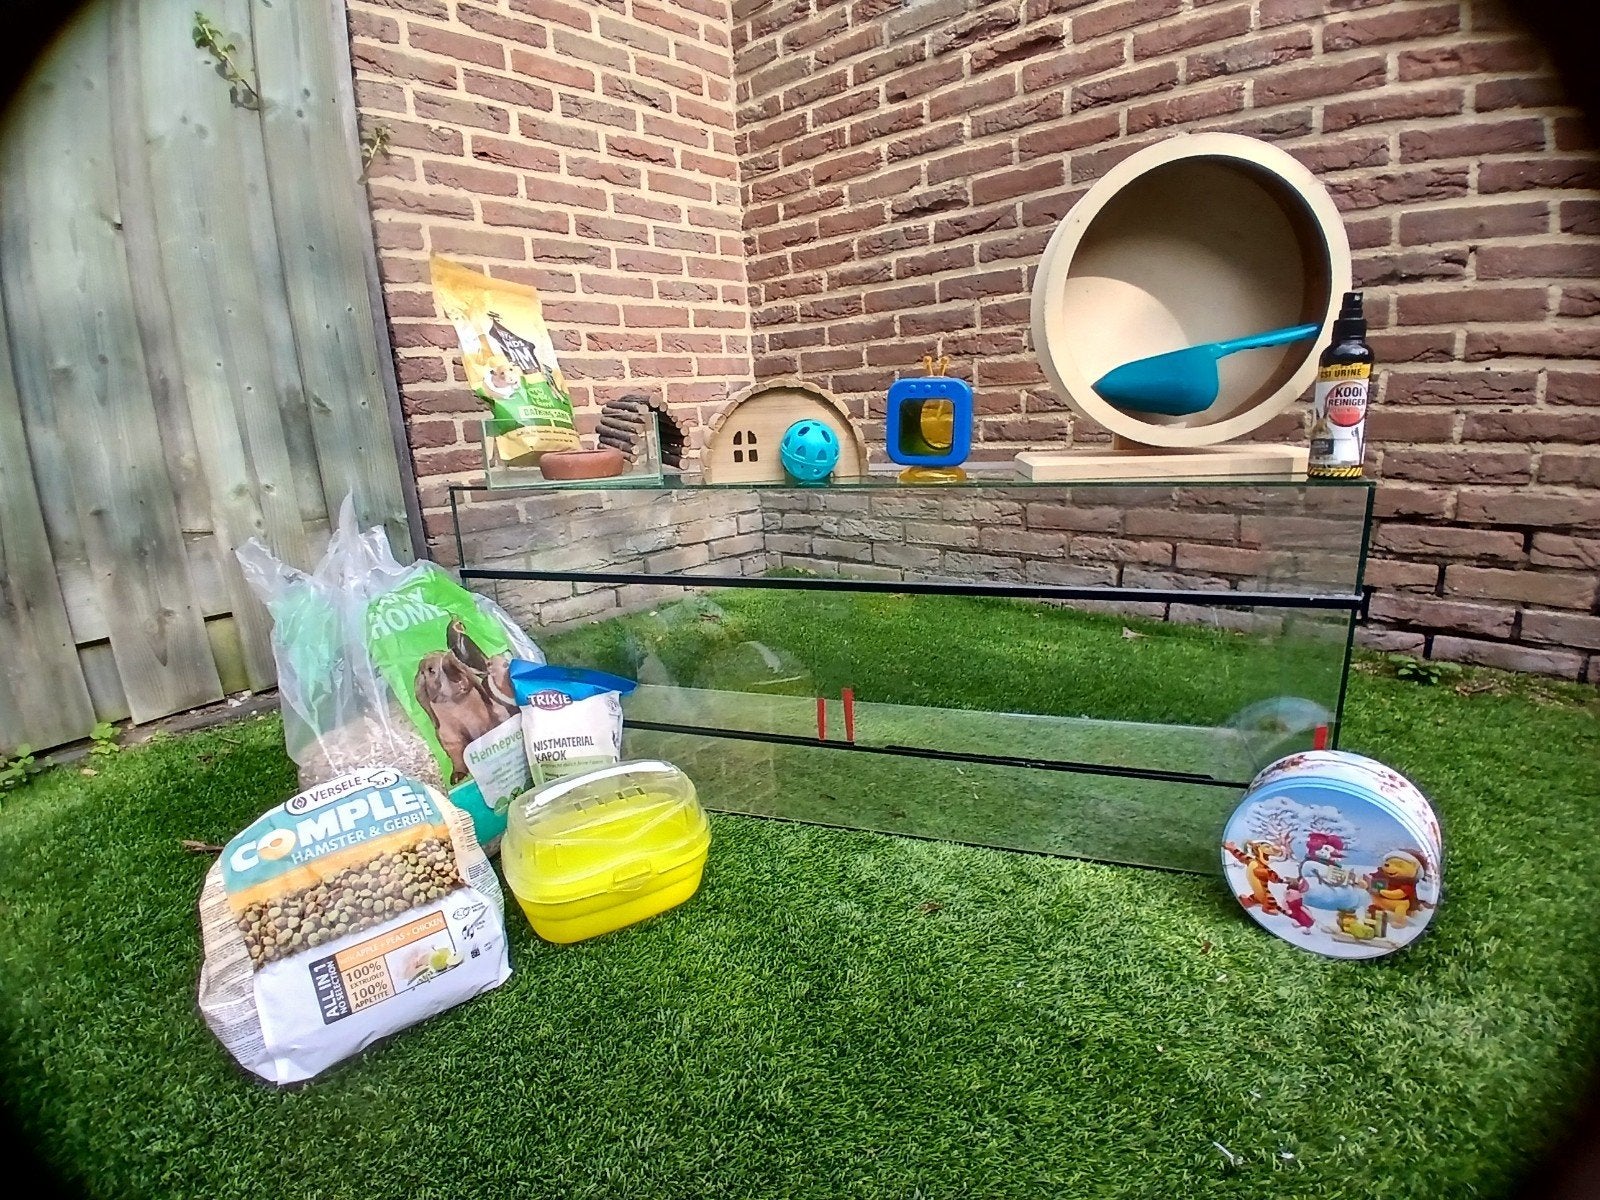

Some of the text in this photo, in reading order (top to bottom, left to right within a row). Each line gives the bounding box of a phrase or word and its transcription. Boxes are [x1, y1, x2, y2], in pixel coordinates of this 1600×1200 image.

[1334, 369, 1362, 378] URINE
[1335, 387, 1362, 398] KOOI
[1328, 398, 1366, 407] REINIGER
[527, 692, 572, 706] TRIXIE
[469, 729, 523, 764] Hennepve
[533, 735, 595, 752] NISTMATERIAL
[535, 750, 567, 763] KAPOK
[291, 811, 425, 865] HAMSTER & GERBI
[386, 933, 405, 946] PEAS
[412, 918, 443, 935] CHICKEN
[346, 961, 381, 982] 100%
[350, 971, 384, 989] EXTRUDED
[313, 963, 340, 1017] ALL IN 1
[326, 960, 348, 1014] NO SELECTION
[352, 980, 387, 1001] 100%
[355, 990, 389, 1009] APPETITE
